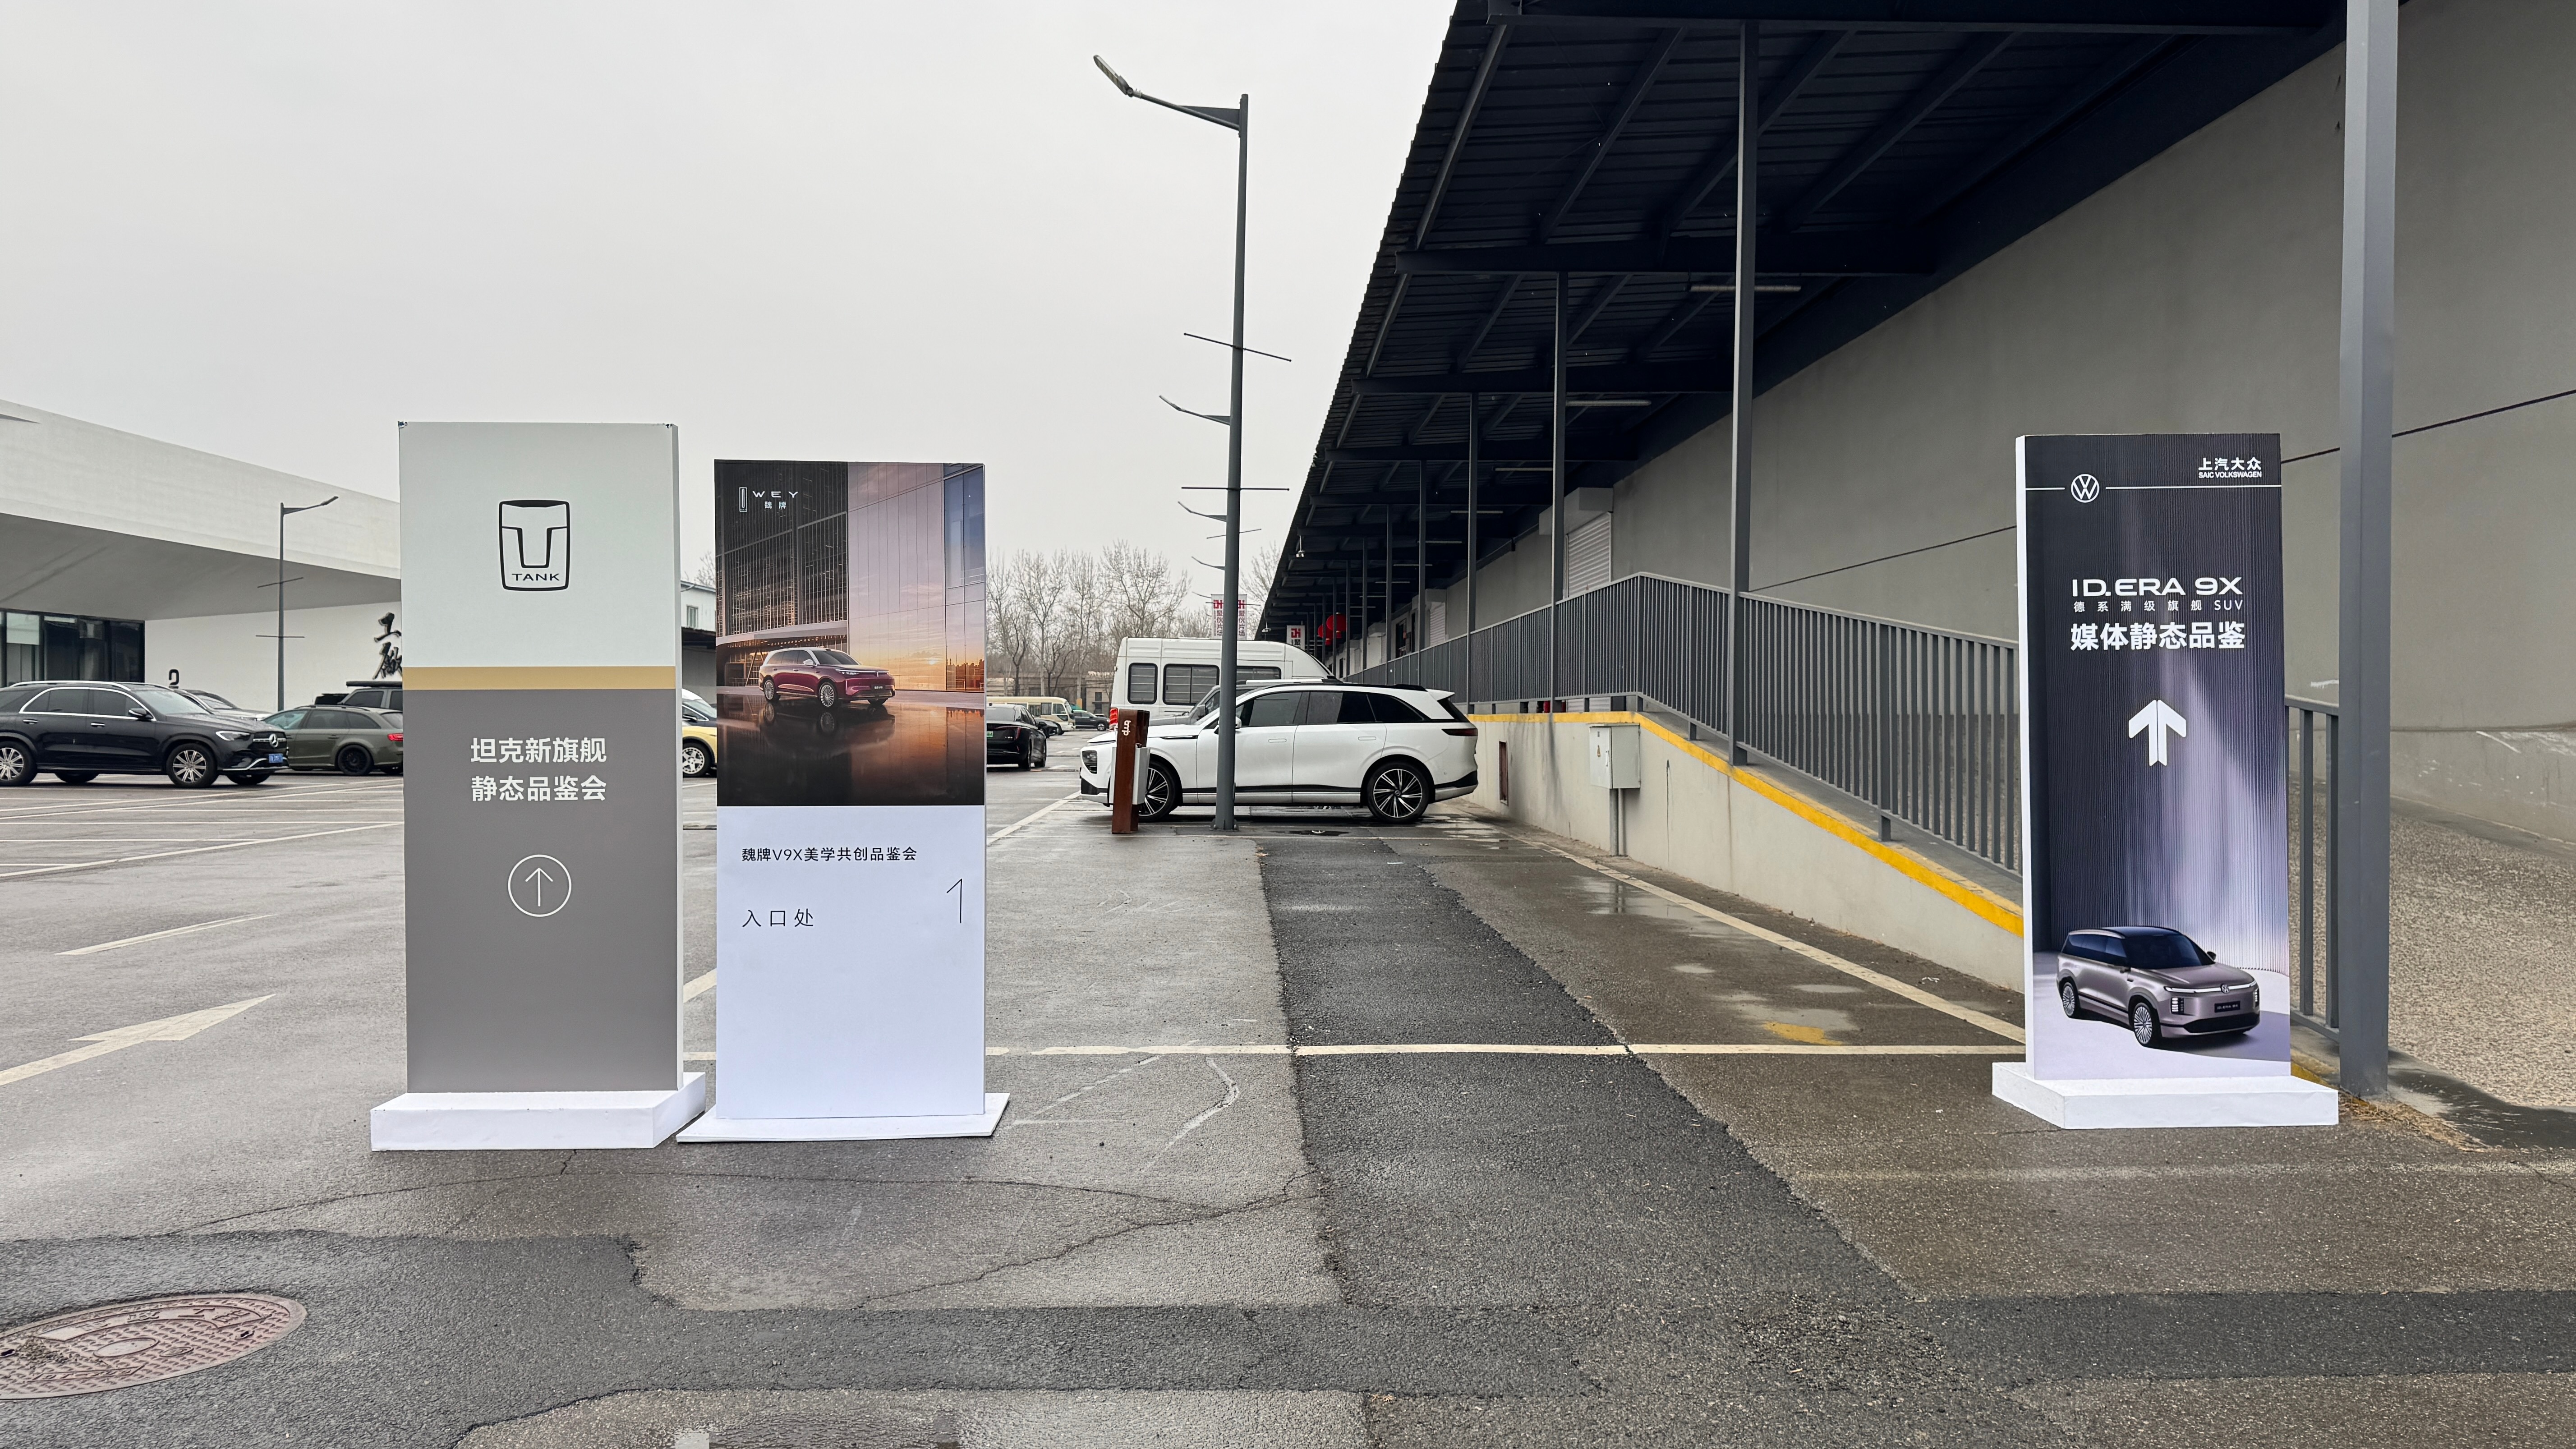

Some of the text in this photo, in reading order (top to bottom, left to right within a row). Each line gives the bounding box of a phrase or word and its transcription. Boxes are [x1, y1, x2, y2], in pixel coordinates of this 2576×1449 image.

[2199, 457, 2261, 470] 上汽大众
[764, 501, 787, 509] 魏牌
[512, 573, 560, 581] TANK
[2072, 577, 2243, 597] ID.ERA 9X
[2074, 599, 2243, 612] 德系满级旗舰 SUV
[2070, 621, 2245, 651] 媒体静态品鉴
[471, 737, 607, 763] 坦克新旗舰
[471, 775, 607, 802] 静态品鉴会
[742, 846, 917, 862] 魏牌V9X美学共创品鉴会
[742, 908, 814, 927] 入口处
